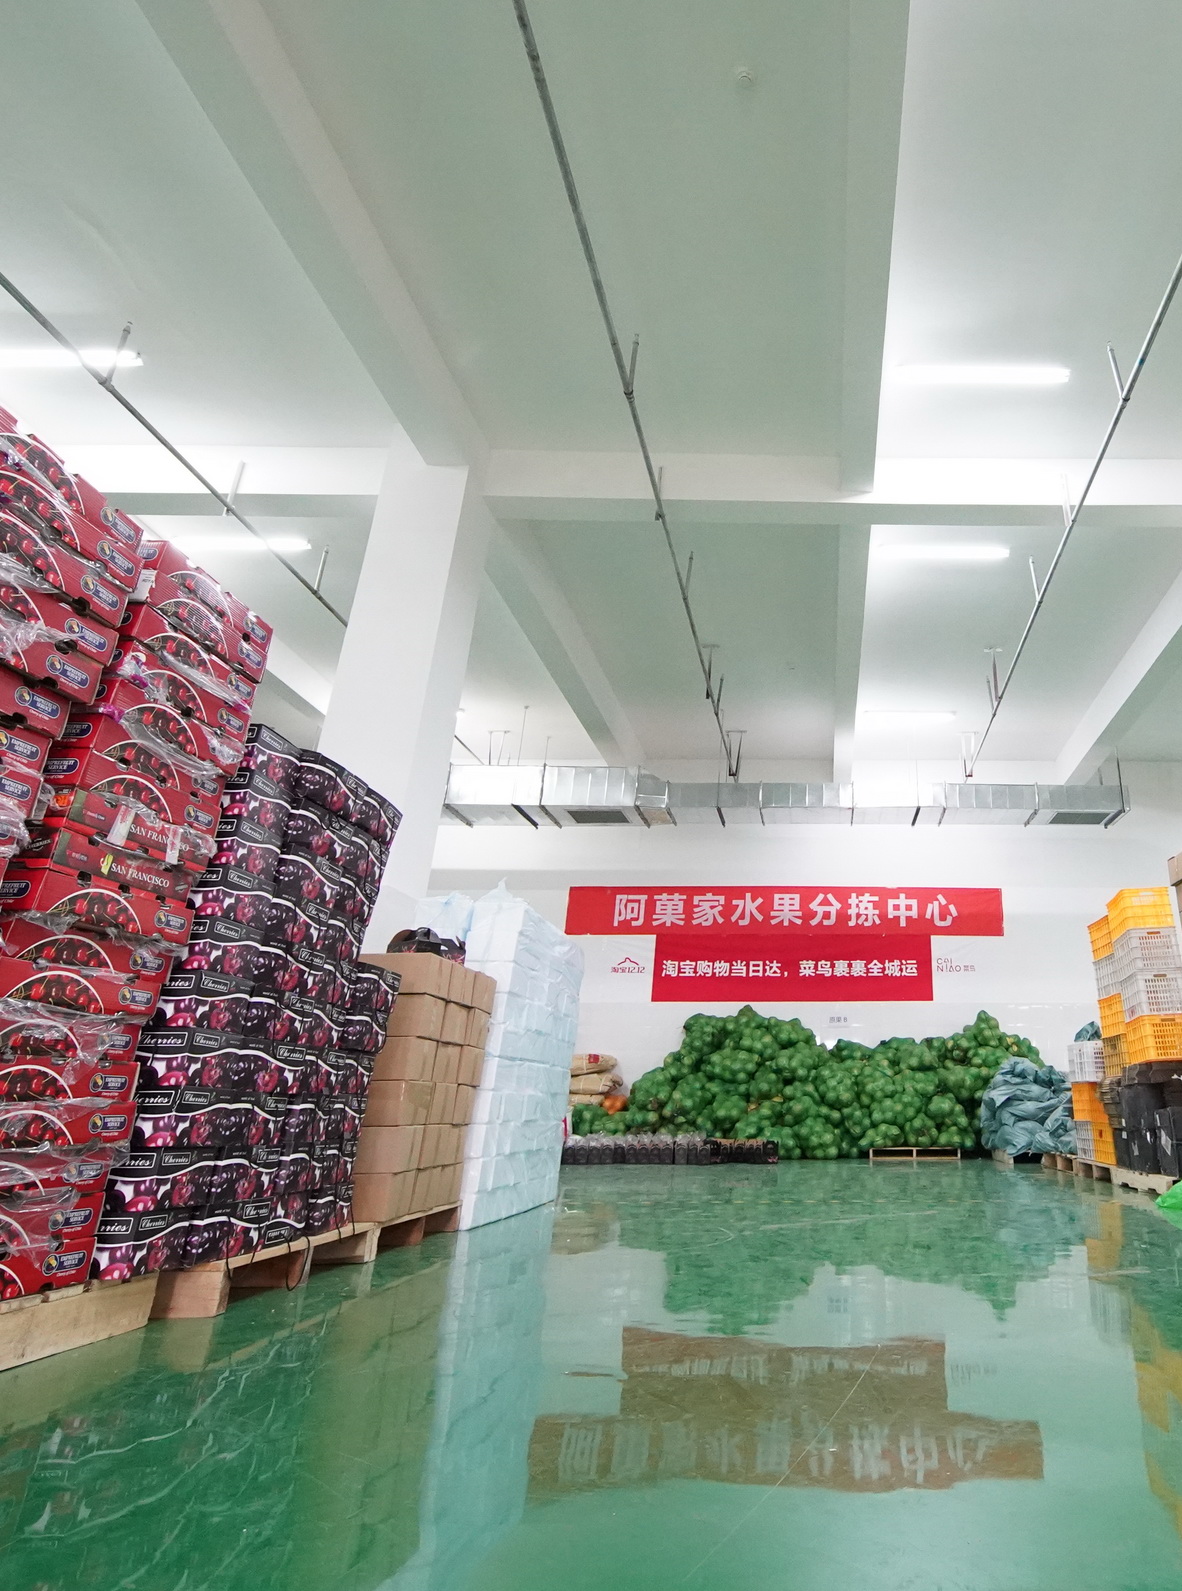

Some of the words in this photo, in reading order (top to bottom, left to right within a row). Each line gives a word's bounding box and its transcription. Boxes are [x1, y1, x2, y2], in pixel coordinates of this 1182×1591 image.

[129, 823, 147, 836] SAN
[111, 863, 127, 875] SAN
[128, 867, 170, 888] FRANCISCO
[613, 893, 958, 927] 阿菓家水果分拣中心
